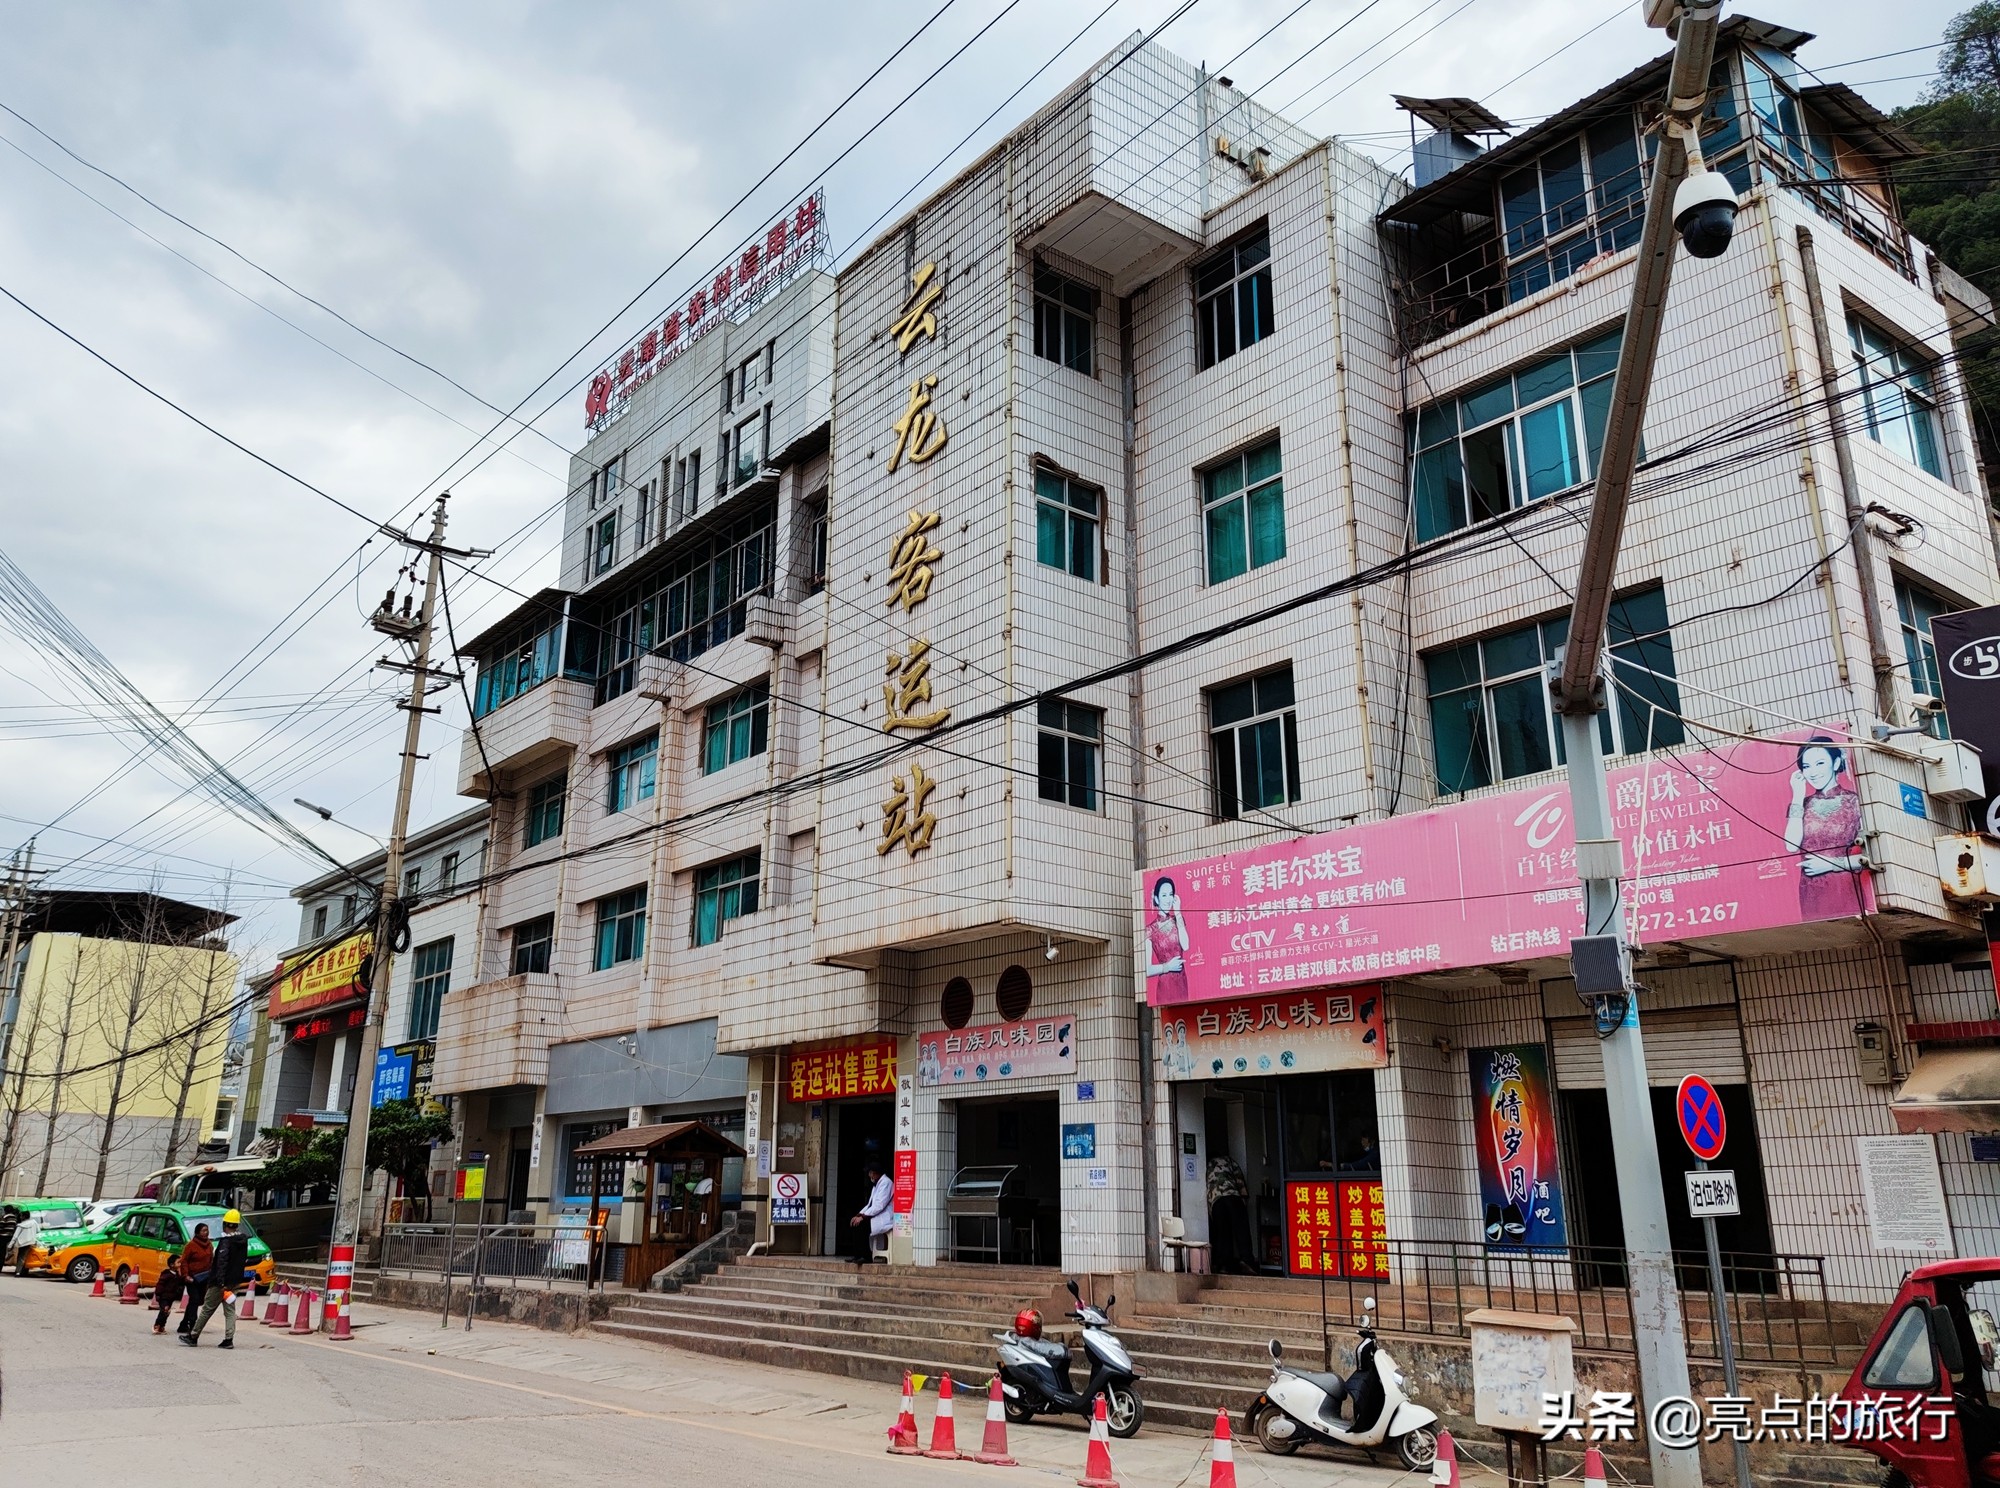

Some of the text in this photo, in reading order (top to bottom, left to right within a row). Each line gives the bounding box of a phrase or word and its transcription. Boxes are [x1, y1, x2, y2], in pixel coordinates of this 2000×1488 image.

[619, 196, 818, 382] 云南省农村信用社
[617, 367, 653, 402] YUNNAN
[656, 341, 686, 373] RURAL
[877, 261, 951, 856] 云龙客运站
[1616, 765, 1719, 811] 爵珠宝
[1631, 818, 1734, 859] 价值永恒
[1186, 861, 1236, 879] SUNFEEL
[1192, 875, 1231, 892] 赛菲尔
[1242, 845, 1363, 896] 赛菲尔珠宝
[1316, 876, 1407, 909] 更纯更有价值
[1659, 889, 1674, 904] 强
[1231, 929, 1276, 951] CCTV
[1312, 941, 1343, 952] CCTV-1
[1197, 995, 1355, 1037] 白族风味园
[945, 1022, 1057, 1054] 白族风味园
[790, 1045, 898, 1099] 客运站售票大
[900, 1079, 912, 1147] 敬业奉献
[1491, 1052, 1527, 1203] 燃情岁月
[1295, 1186, 1330, 1205] 饵丝
[1347, 1186, 1384, 1204] 炒饭
[1532, 1180, 1555, 1224] 酒吧
[1690, 1180, 1735, 1207] 泊位除外
[772, 1207, 806, 1219] 无烟单位
[1296, 1208, 1331, 1226] 米线
[1349, 1208, 1386, 1226] 盖饭
[1351, 1230, 1387, 1249] 各种
[1298, 1251, 1333, 1271] 面条
[1351, 1252, 1389, 1272] 炒菜
